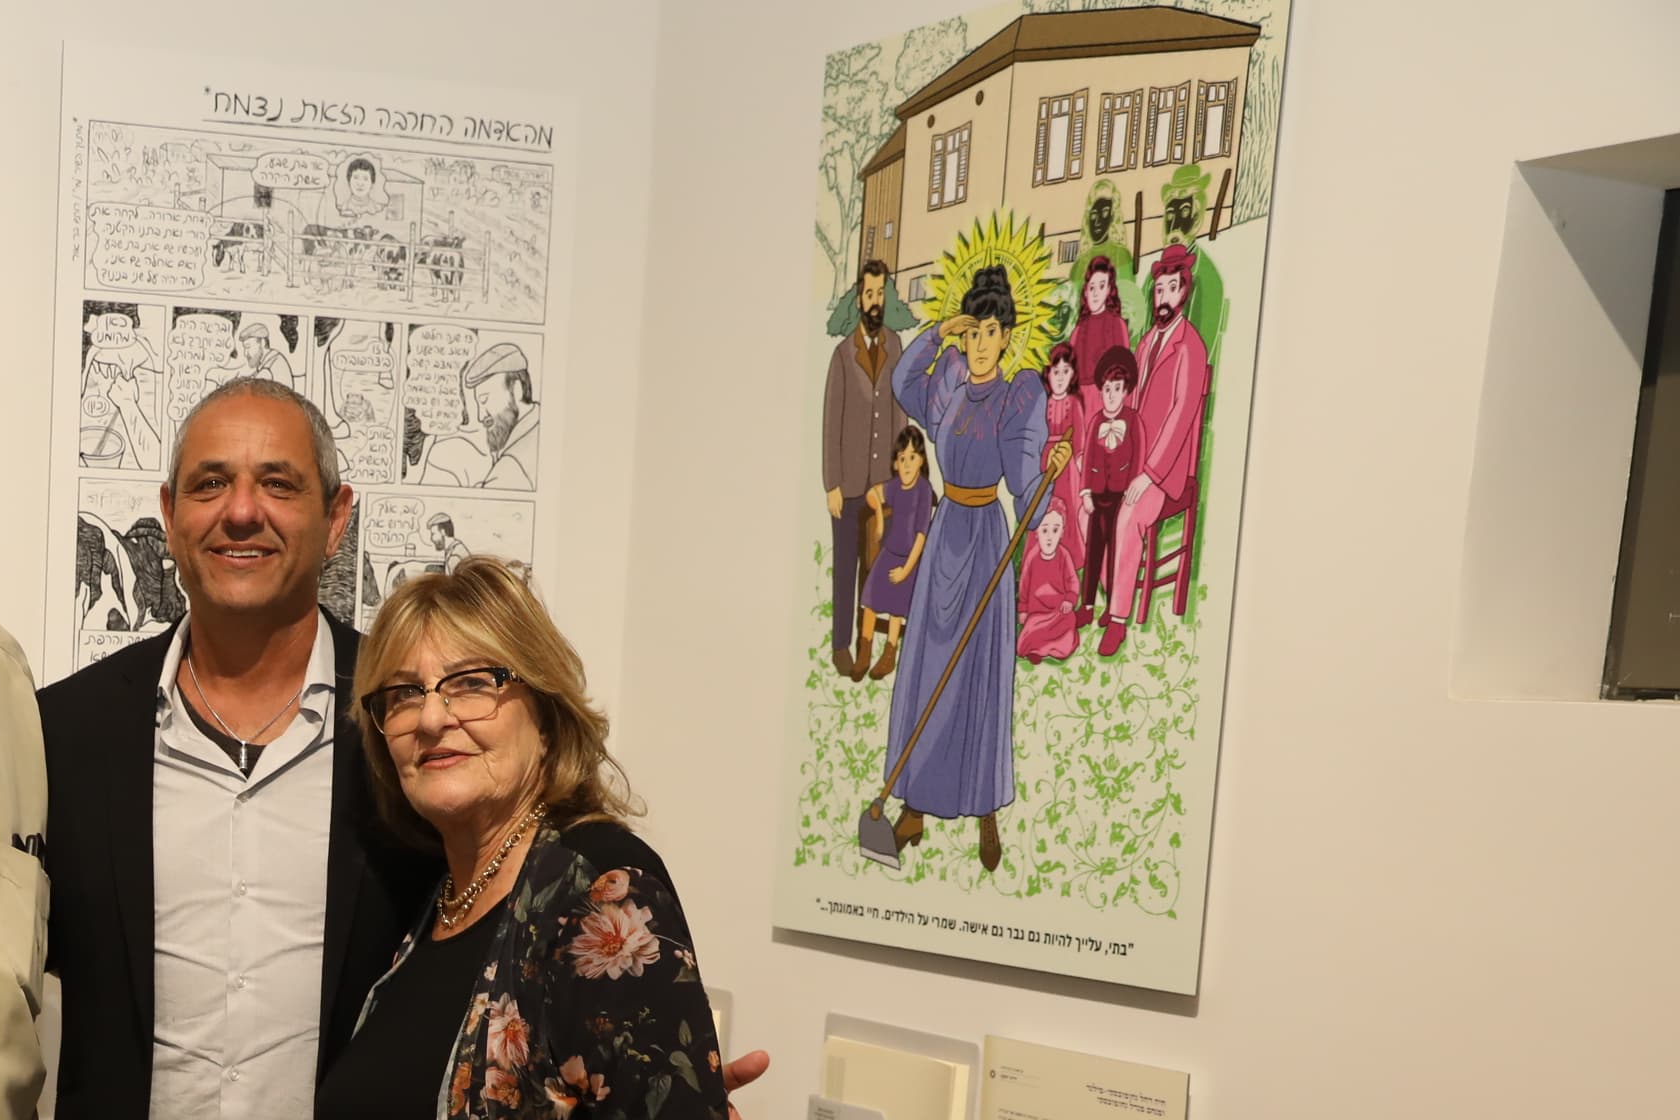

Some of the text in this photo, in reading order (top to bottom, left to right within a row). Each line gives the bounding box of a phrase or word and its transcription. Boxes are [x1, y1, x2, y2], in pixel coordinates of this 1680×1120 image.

[290, 99, 365, 125] הזאת
[376, 108, 454, 136] החרבה
[464, 117, 553, 148] מהאדמה
[91, 207, 110, 217] את
[114, 207, 138, 220] לקחה
[124, 241, 139, 251] בת
[141, 243, 159, 252] את
[181, 277, 195, 286] מה
[106, 316, 127, 330] כאן
[97, 332, 130, 344] מקומנו
[366, 518, 384, 528] את
[867, 907, 879, 919] חיי
[881, 909, 914, 924] הילדים.
[918, 912, 928, 926] על
[931, 916, 956, 930] שמרי
[959, 921, 988, 935] אישה.
[991, 924, 1003, 937] גם
[1007, 927, 1025, 940] גבר
[1028, 930, 1040, 943] גם
[1044, 933, 1072, 947] להיות
[1075, 936, 1102, 952] עלייך
